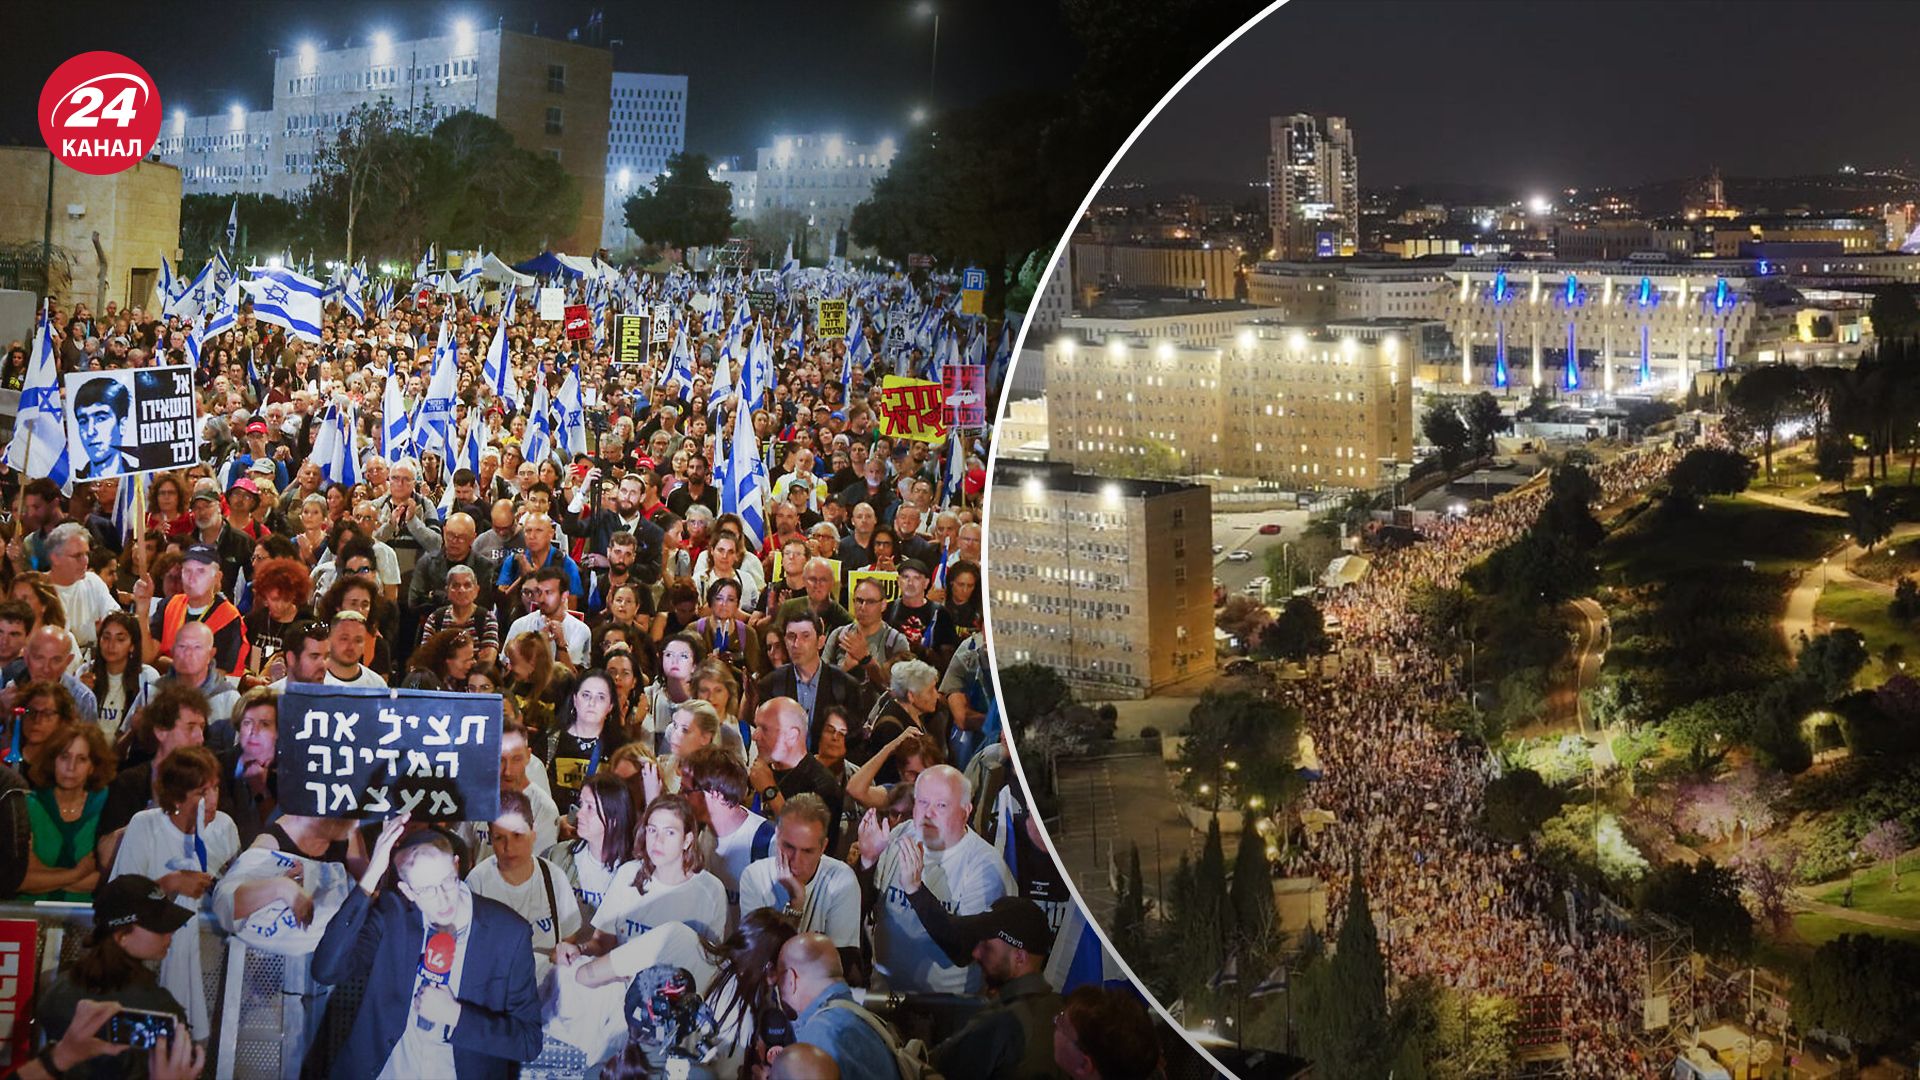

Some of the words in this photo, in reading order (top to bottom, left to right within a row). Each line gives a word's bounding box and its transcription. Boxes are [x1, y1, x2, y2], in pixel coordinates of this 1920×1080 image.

[172, 371, 190, 395] אל
[141, 396, 191, 421] תשאירו
[140, 420, 175, 444] אותם
[176, 418, 193, 440] גם
[170, 438, 194, 463] לבד
[295, 709, 360, 743] את
[378, 708, 490, 746] תציל
[307, 745, 459, 779] המדינה
[305, 781, 458, 816] מעצמך
[109, 912, 138, 927] POLICE
[427, 948, 446, 969] 14
